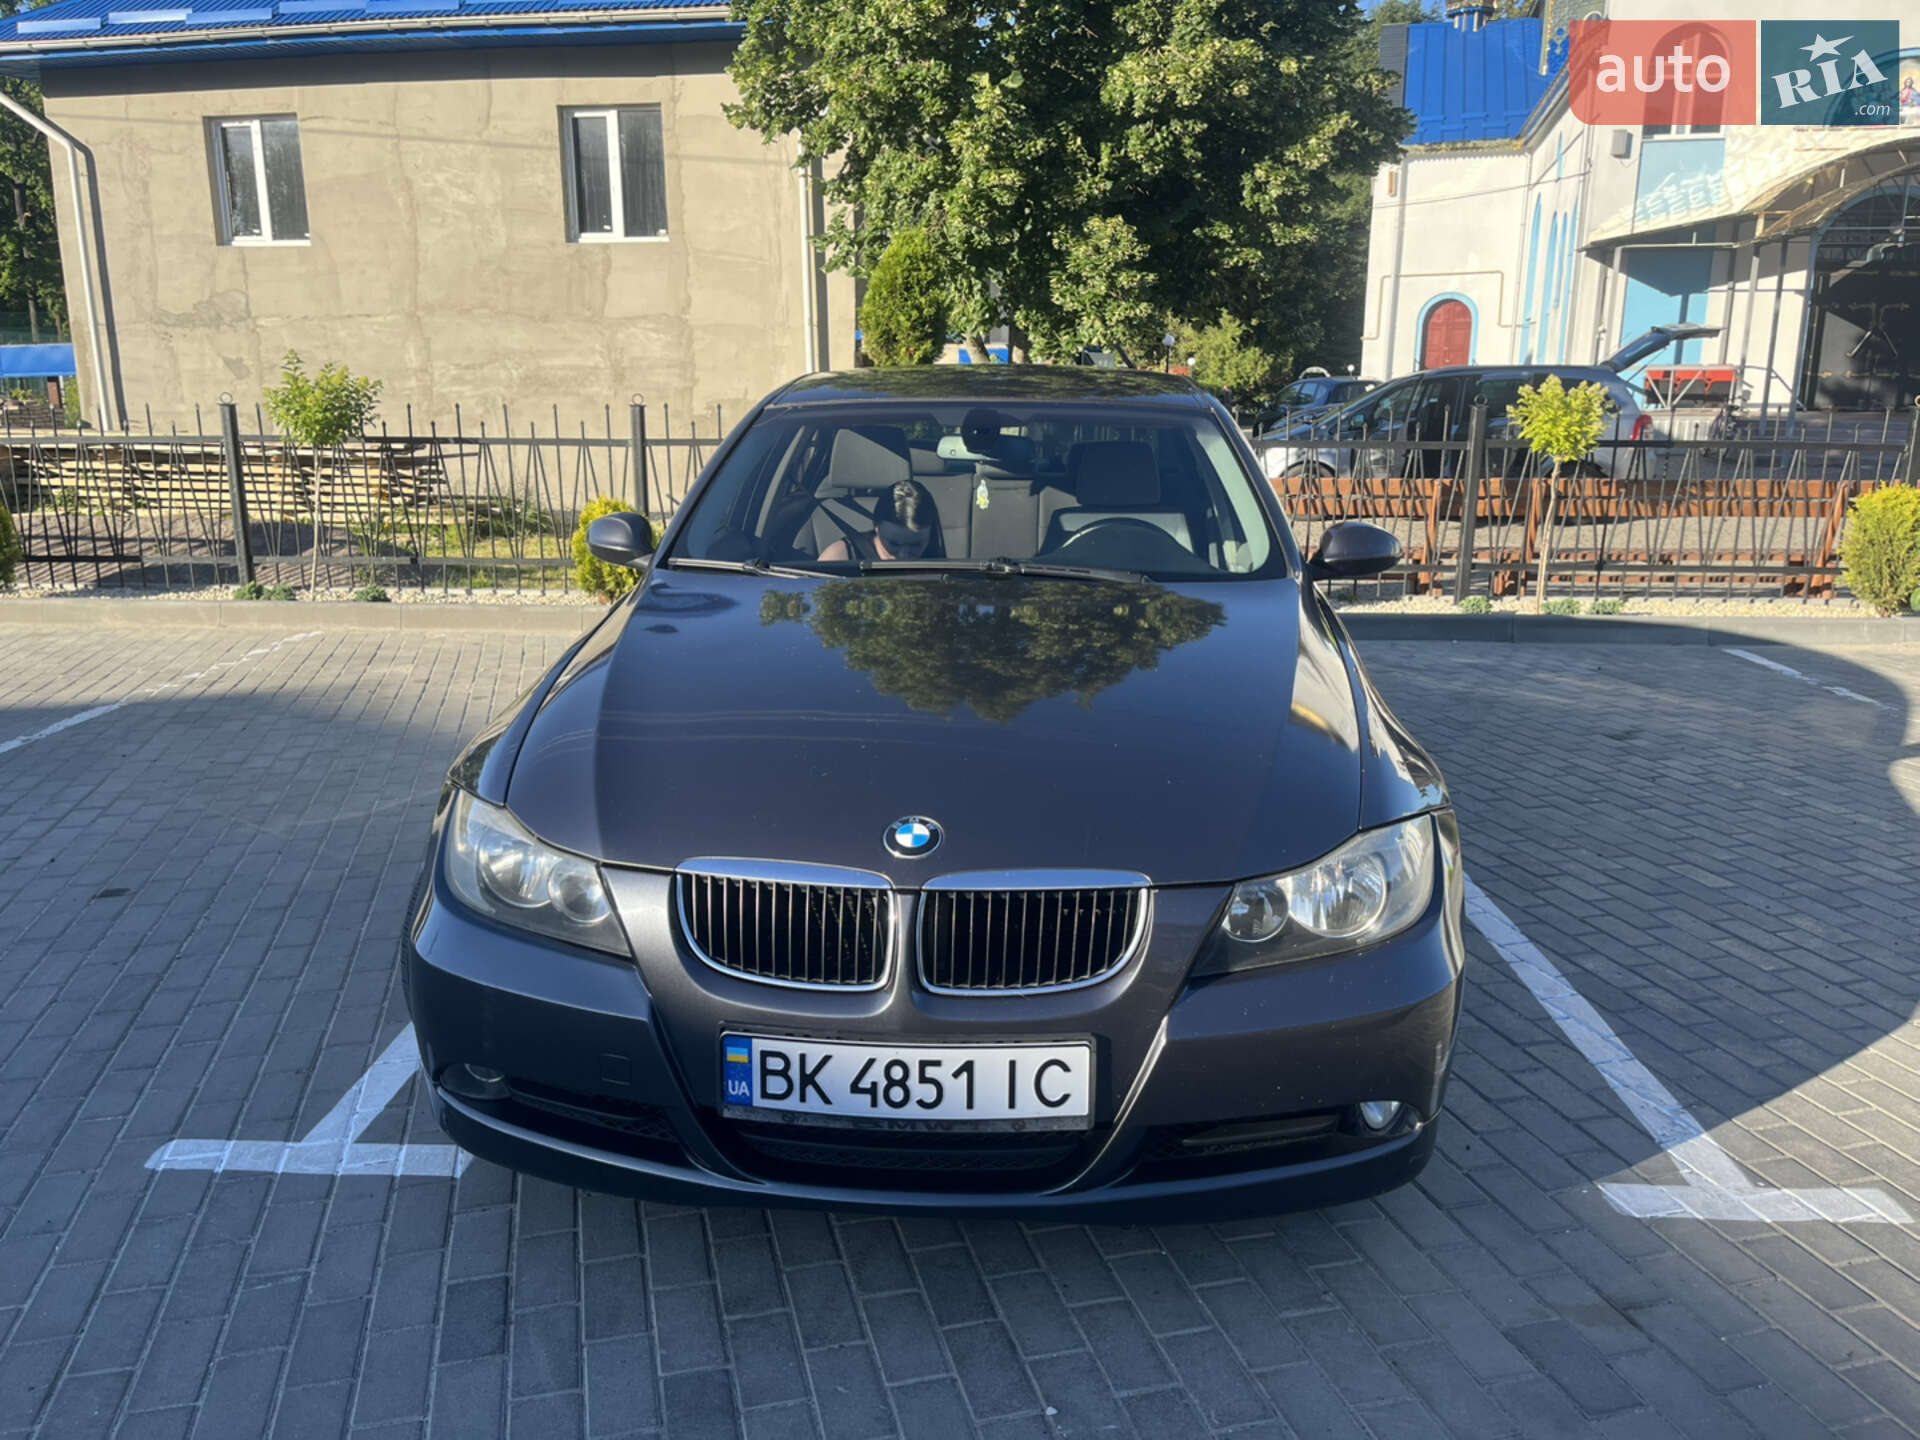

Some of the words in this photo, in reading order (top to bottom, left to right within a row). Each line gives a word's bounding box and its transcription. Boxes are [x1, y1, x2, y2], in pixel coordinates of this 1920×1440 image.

[728, 1079, 750, 1096] UA
[759, 1050, 833, 1106] BK
[849, 1057, 975, 1110] 4851
[1007, 1058, 1072, 1110] IC
